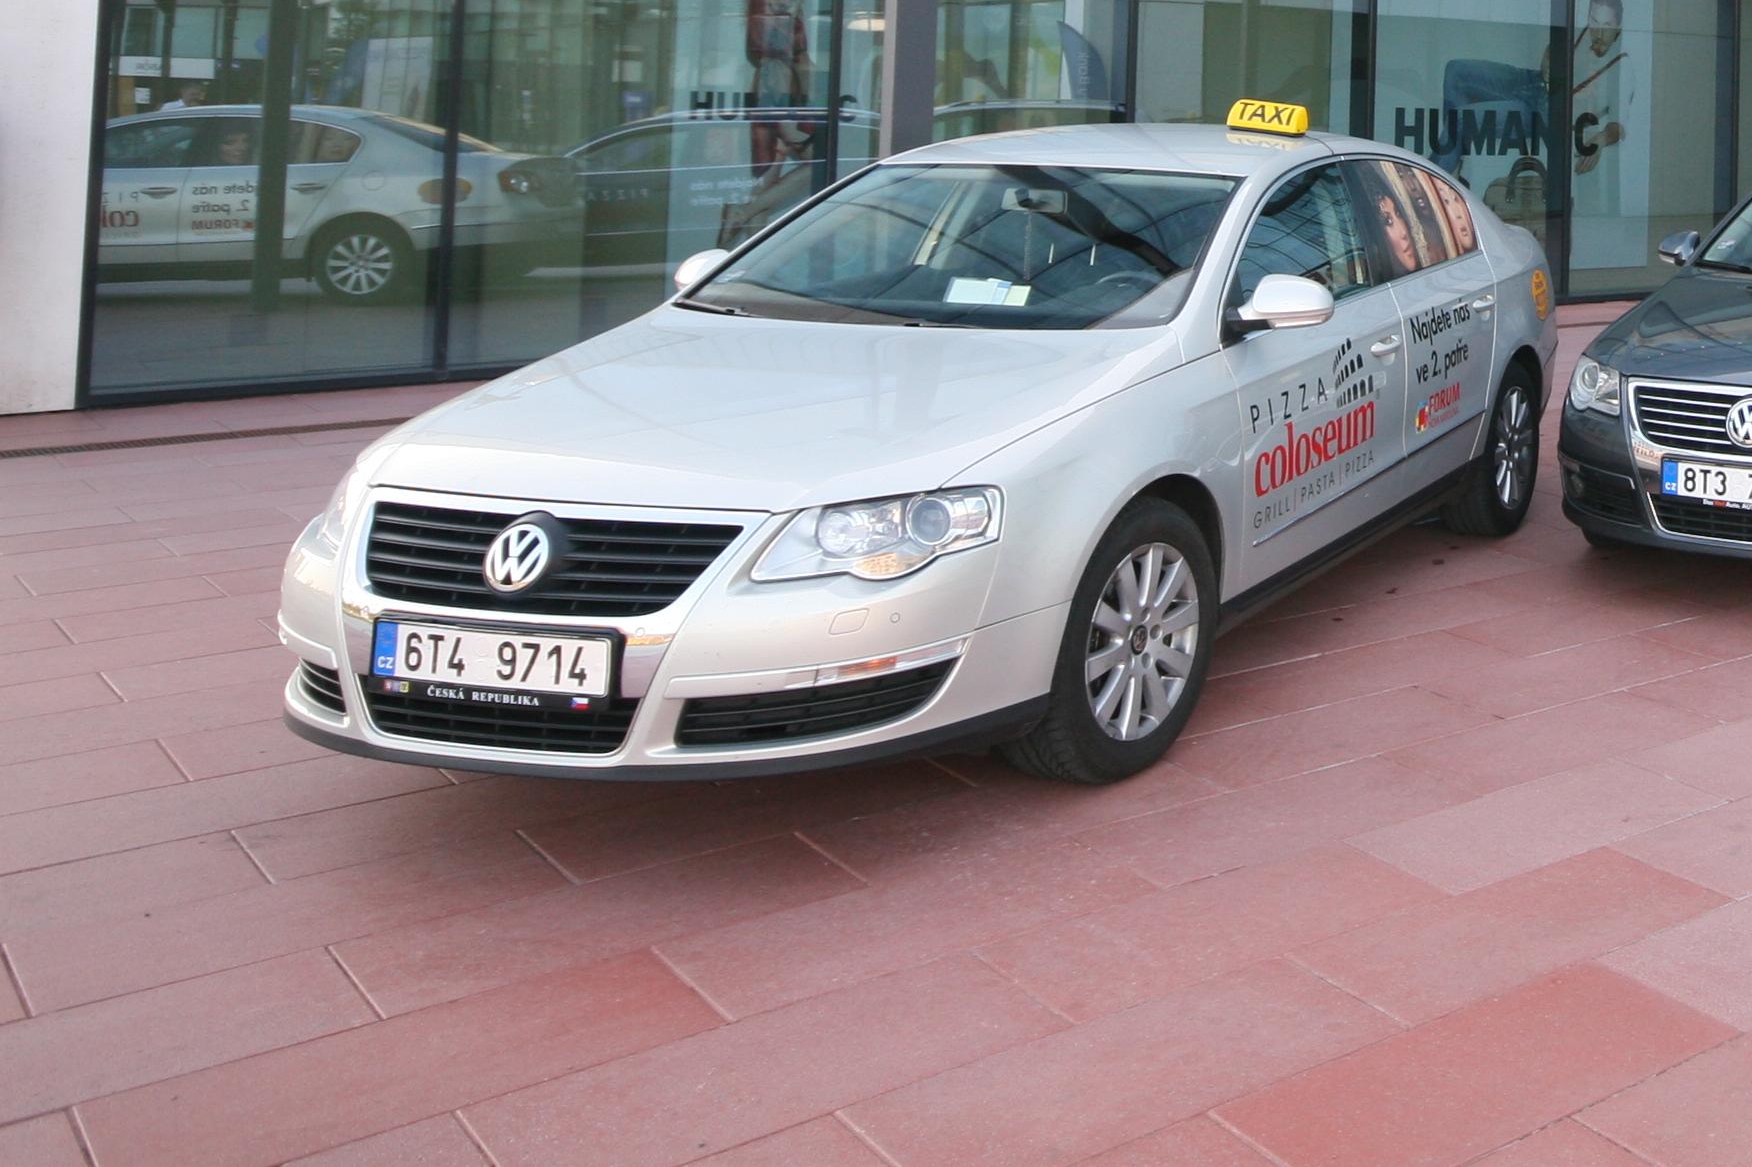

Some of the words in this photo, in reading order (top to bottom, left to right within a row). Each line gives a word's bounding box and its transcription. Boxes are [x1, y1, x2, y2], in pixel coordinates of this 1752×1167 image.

[1239, 101, 1297, 127] TAXI
[1409, 306, 1452, 345] Najdete
[1451, 298, 1471, 328] nás
[1416, 365, 1429, 384] ve
[1431, 352, 1443, 379] 2.
[1444, 339, 1469, 379] patře
[1250, 376, 1328, 433] PIZZA
[1254, 400, 1375, 498] coloseum
[1253, 501, 1291, 530] GRILL
[1301, 474, 1336, 502] PASTA
[1345, 451, 1375, 478] PIZZA
[1683, 466, 1728, 497] 8T3
[377, 655, 394, 669] CZ
[403, 631, 466, 678] 6T4
[496, 640, 588, 687] 9714
[426, 684, 465, 701] ČESKÁ
[471, 690, 540, 707] REPUBLIKA
